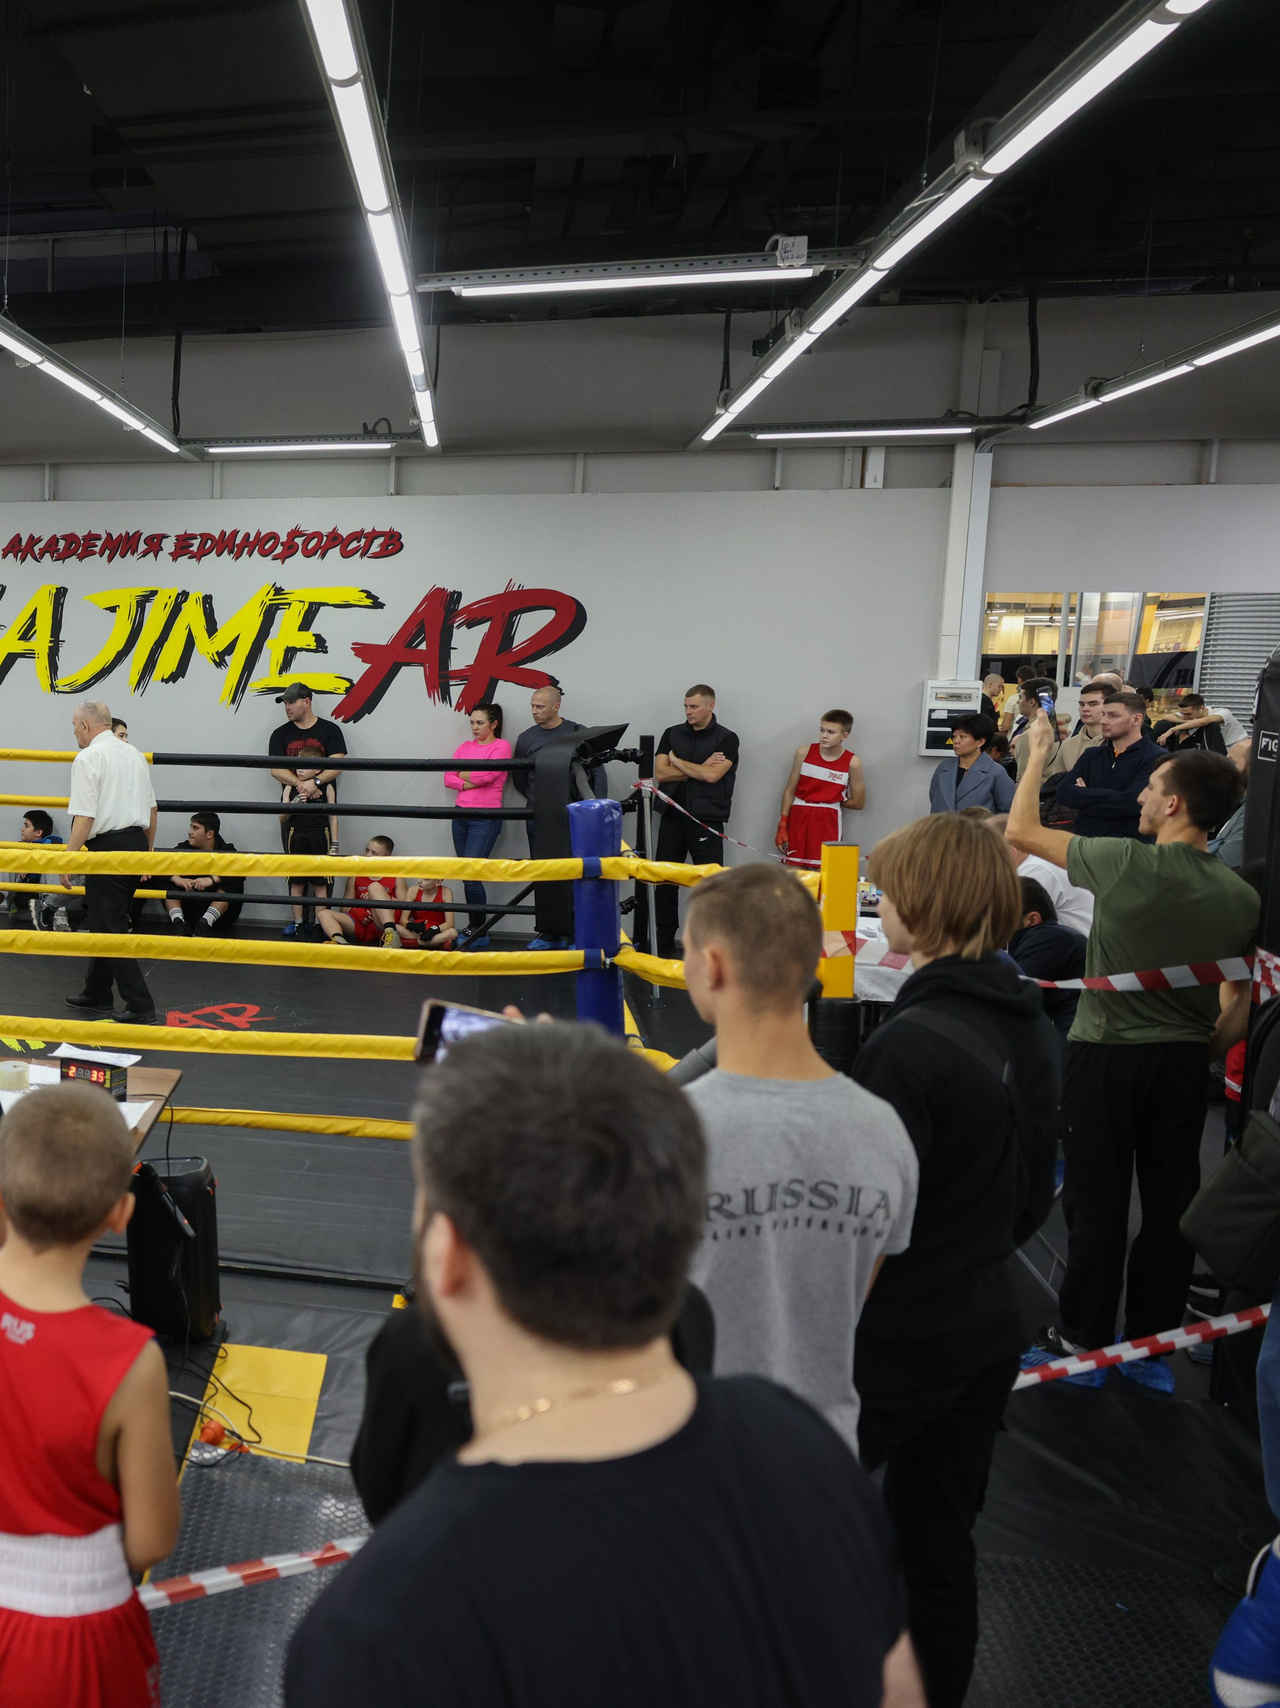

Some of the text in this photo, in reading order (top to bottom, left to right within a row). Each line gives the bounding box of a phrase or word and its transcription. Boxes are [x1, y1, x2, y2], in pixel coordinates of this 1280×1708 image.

[1, 524, 405, 565] АКАДЕМИЯ ЕДИНОБОРСТВ
[706, 1178, 892, 1223] RUSSIA
